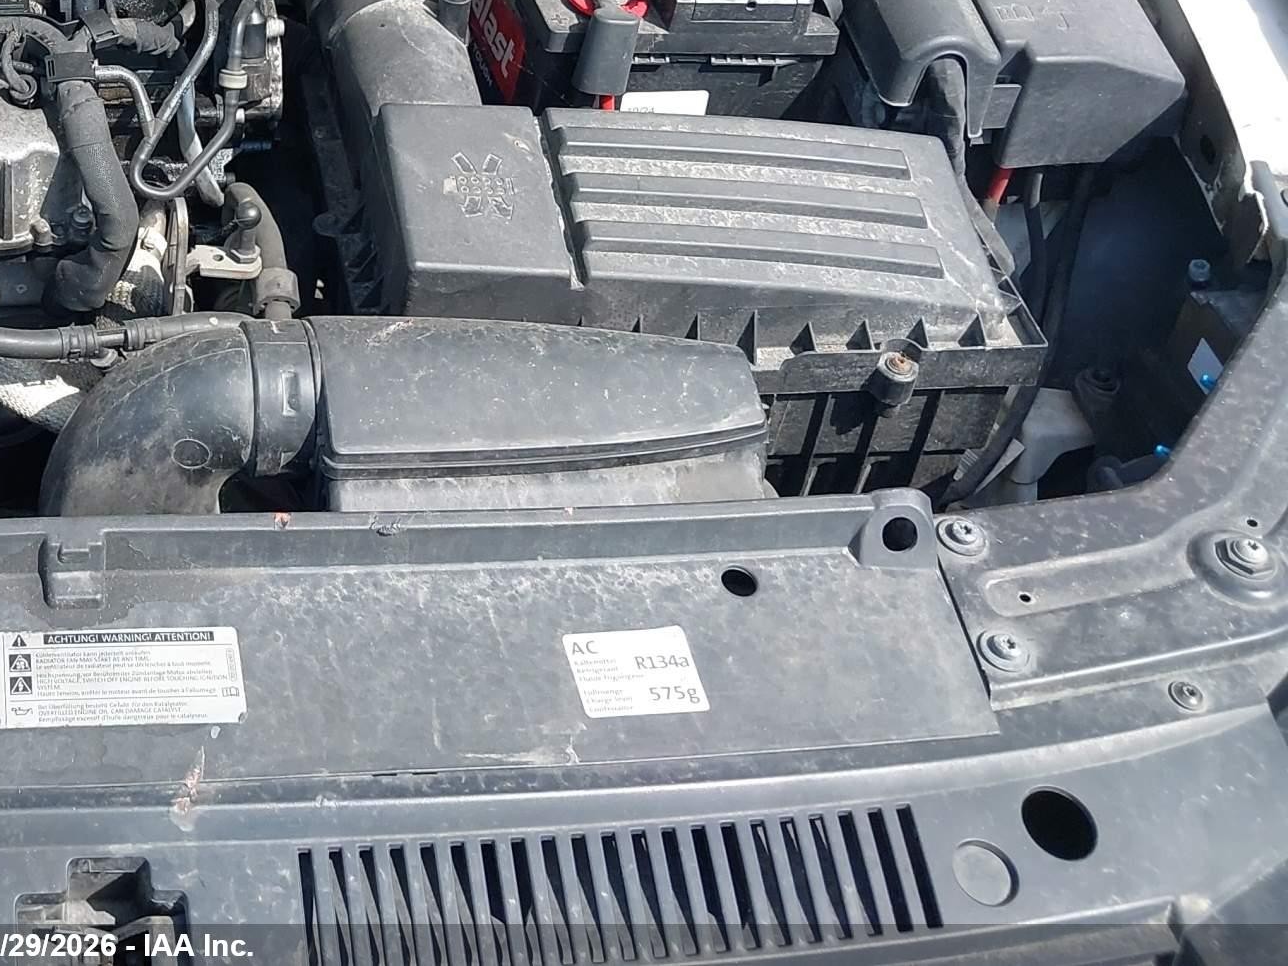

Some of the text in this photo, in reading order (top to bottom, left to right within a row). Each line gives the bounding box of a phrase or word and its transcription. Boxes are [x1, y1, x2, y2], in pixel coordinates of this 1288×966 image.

[48, 631, 211, 643] ACHTUNG! WARNING! ATTENTION!
[571, 640, 600, 655] AC
[634, 655, 689, 670] R134a
[648, 685, 701, 704] 575g
